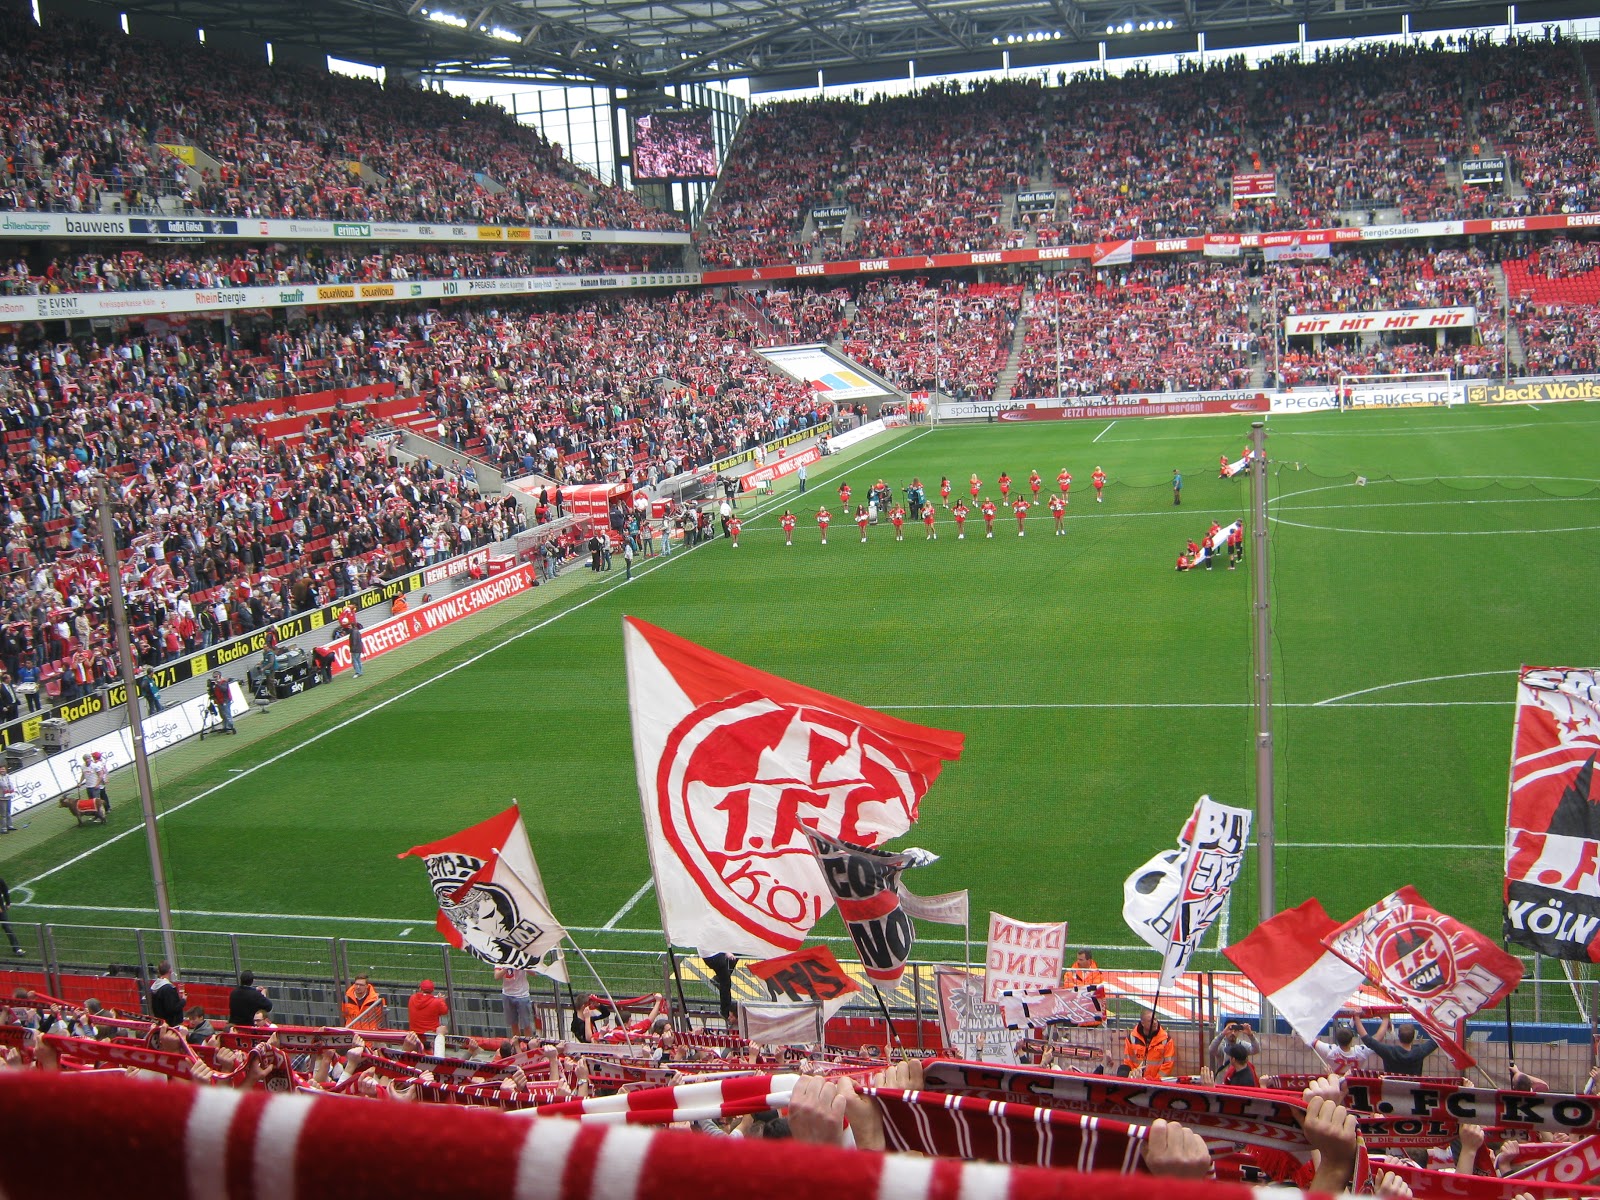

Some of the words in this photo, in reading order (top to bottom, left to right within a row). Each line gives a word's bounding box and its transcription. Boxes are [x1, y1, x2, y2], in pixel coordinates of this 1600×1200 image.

[65, 217, 124, 233] bauwens
[337, 224, 360, 236] erima
[1491, 218, 1525, 231] REWE
[1336, 227, 1419, 239] RheinEnergieStadion
[1155, 240, 1187, 251] REWE
[1240, 236, 1258, 246] WE
[971, 252, 1002, 263] REWE
[1038, 247, 1069, 259] REWE
[795, 265, 825, 276] REWE
[859, 260, 889, 271] REWE
[442, 282, 458, 295] HDI
[49, 297, 78, 309] EVENT
[195, 291, 246, 305] RheinEnergie
[1340, 317, 1374, 331] HIT
[1384, 315, 1419, 328] HIT
[1428, 313, 1465, 326] HIT
[1295, 320, 1330, 333] HIT
[1492, 384, 1543, 402] Jack
[1062, 408, 1085, 418] JETZT
[1167, 402, 1204, 413] werden!
[427, 565, 448, 584] REWE
[448, 557, 468, 576] REWE
[469, 550, 487, 569] RWE
[361, 591, 381, 609] Köln
[423, 572, 524, 623] WWW.FC-FANSHOP.DE
[217, 641, 249, 665] Radio
[276, 618, 304, 642] 107,1
[283, 674, 293, 683] sky
[291, 681, 305, 693] sky
[60, 698, 102, 722] Radio
[1508, 897, 1600, 945] KÖLN
[1394, 941, 1439, 978] 1.FC
[1409, 963, 1441, 990] KÖLN
[286, 1035, 307, 1044] FC
[1005, 1092, 1031, 1104] DIE
[1038, 1096, 1099, 1113] MACHT
[1109, 1103, 1142, 1115] AM
[1147, 1108, 1202, 1124] RHEIN
[1347, 1086, 1394, 1114] 1.
[1410, 1089, 1477, 1118] FC
